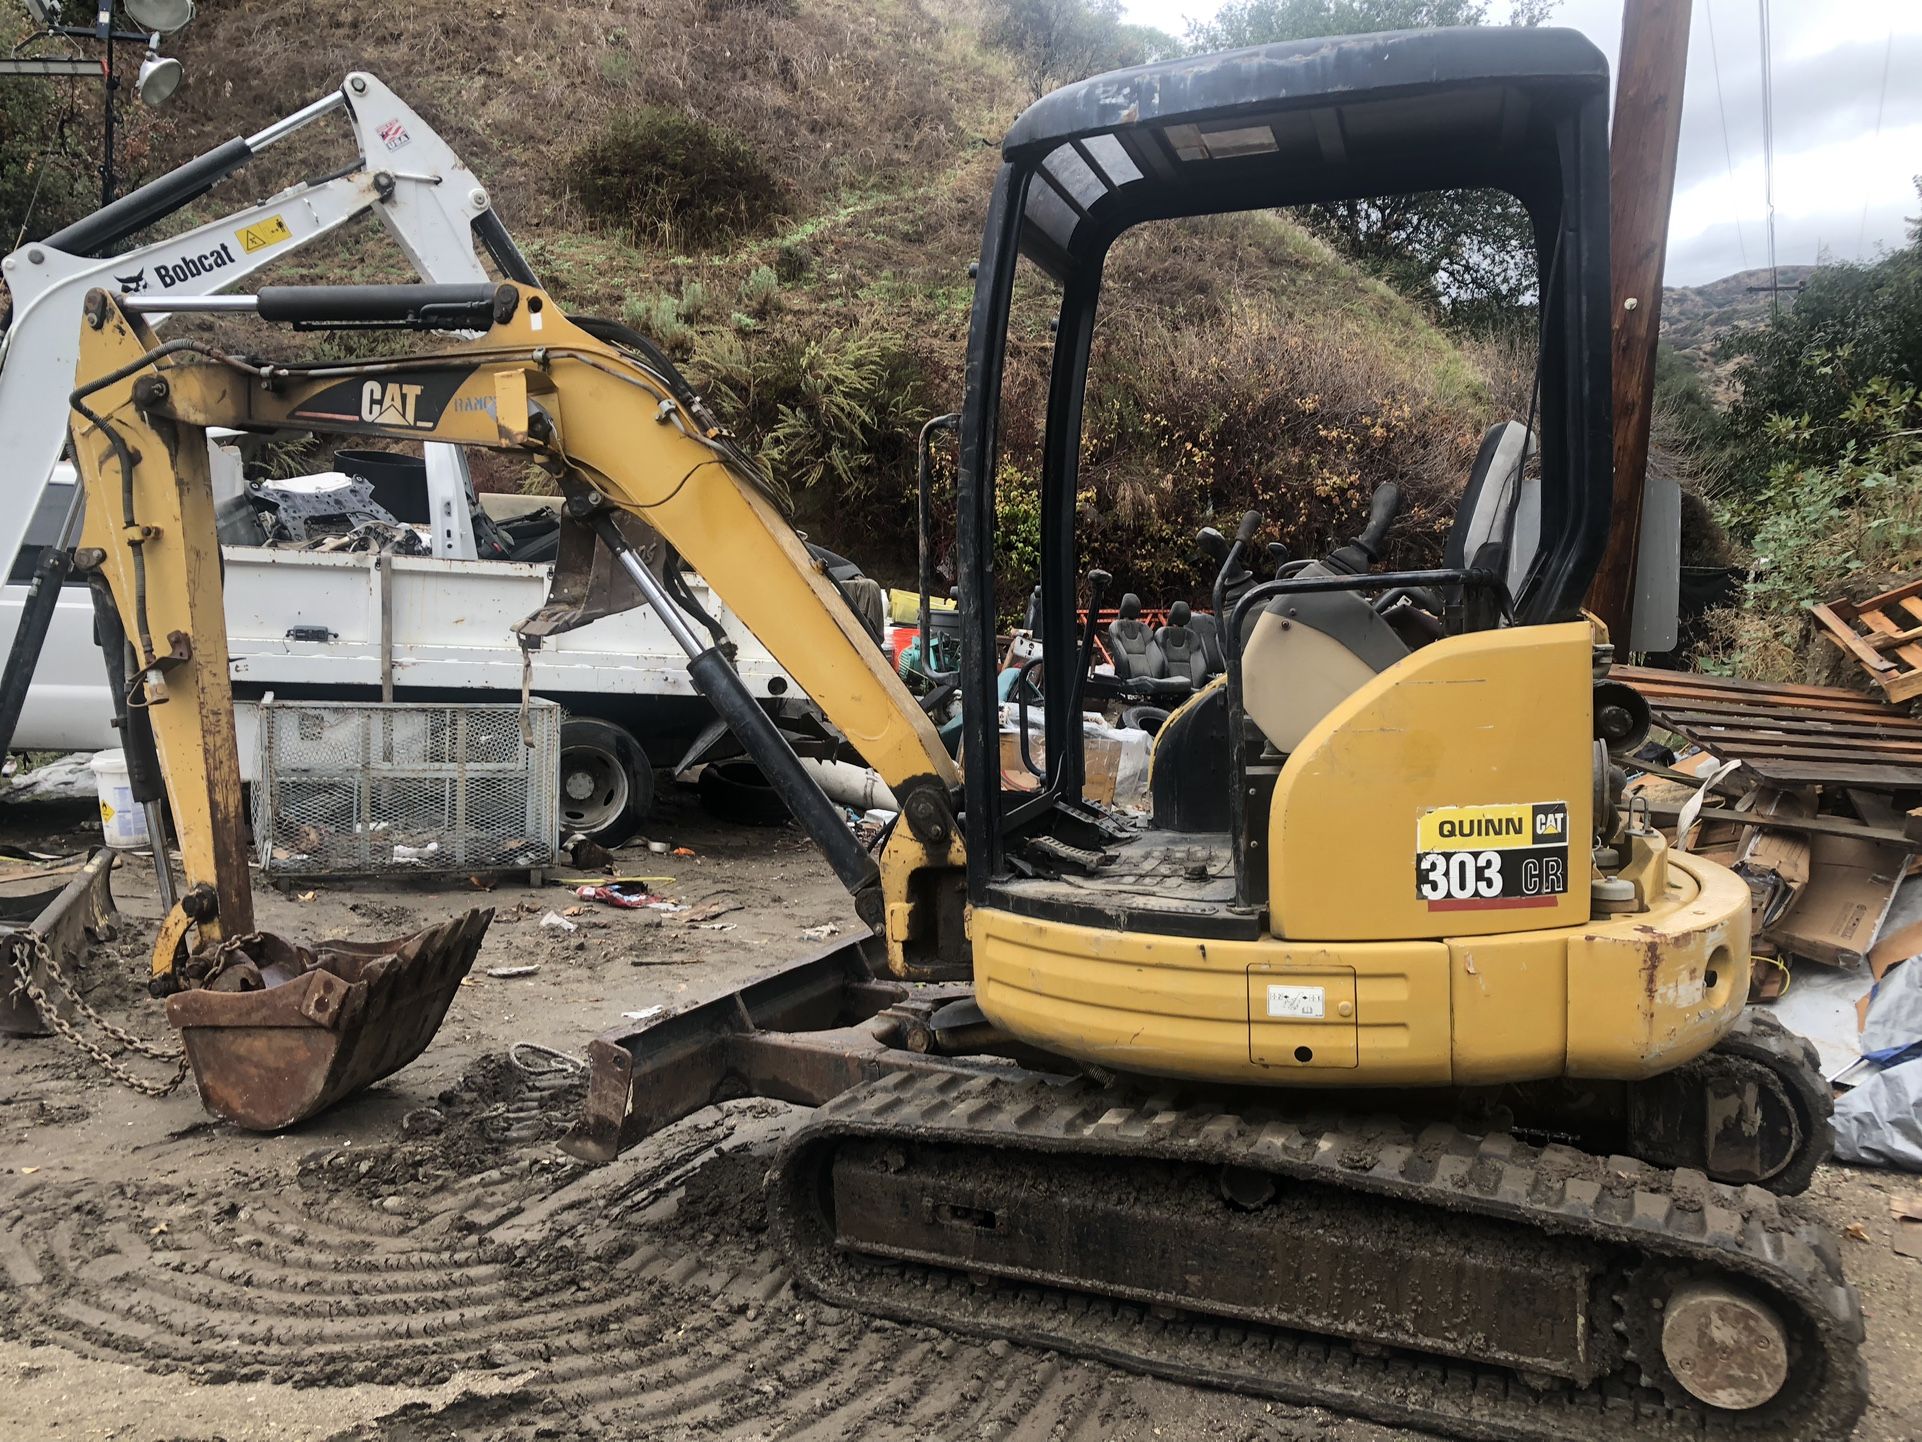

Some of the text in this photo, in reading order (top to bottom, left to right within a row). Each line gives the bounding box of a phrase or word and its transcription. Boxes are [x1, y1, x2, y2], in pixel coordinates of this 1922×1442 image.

[154, 242, 235, 288] Bobcat
[361, 380, 423, 426] CAT
[1438, 812, 1564, 838] QUINN CAT
[1420, 850, 1564, 901] 303 CR
